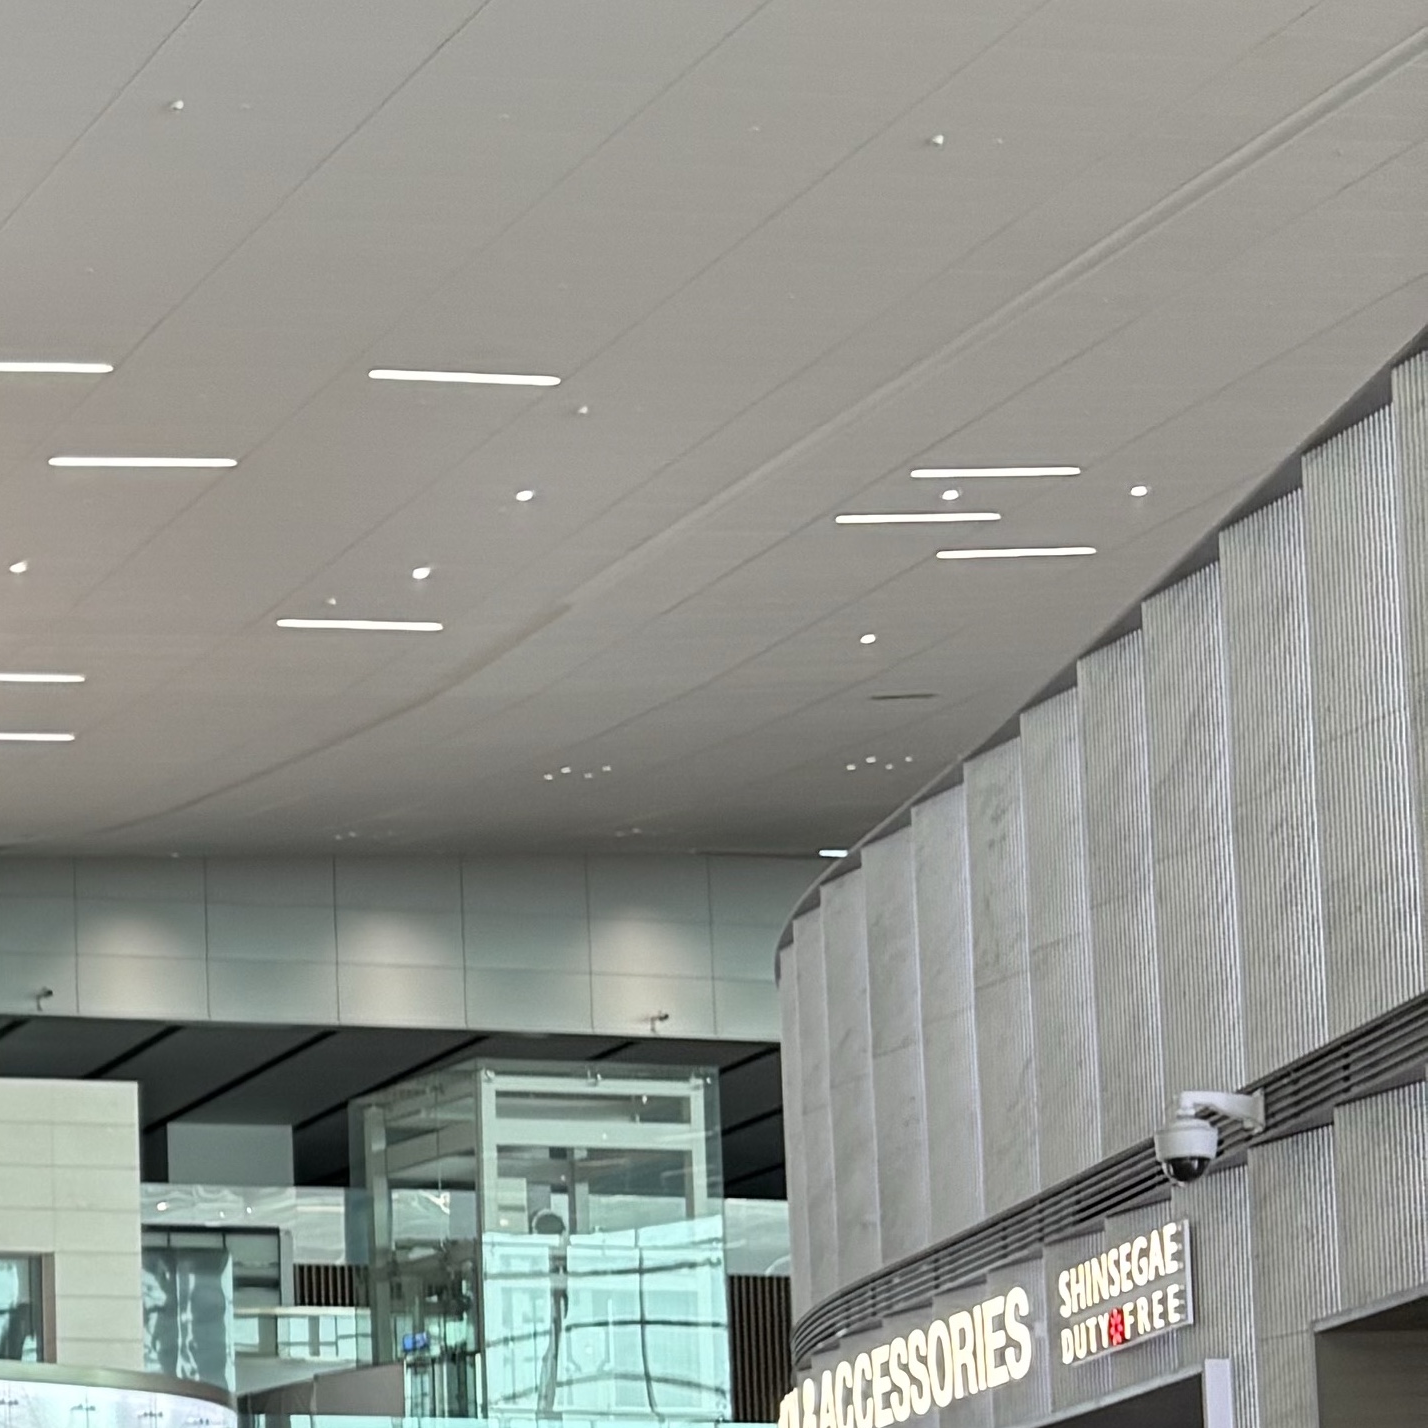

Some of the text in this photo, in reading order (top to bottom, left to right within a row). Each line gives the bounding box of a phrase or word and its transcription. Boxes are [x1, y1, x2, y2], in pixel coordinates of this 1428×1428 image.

[1058, 1221, 1182, 1319] SHINSEGAE
[1060, 1283, 1184, 1365] DUTY FREE
